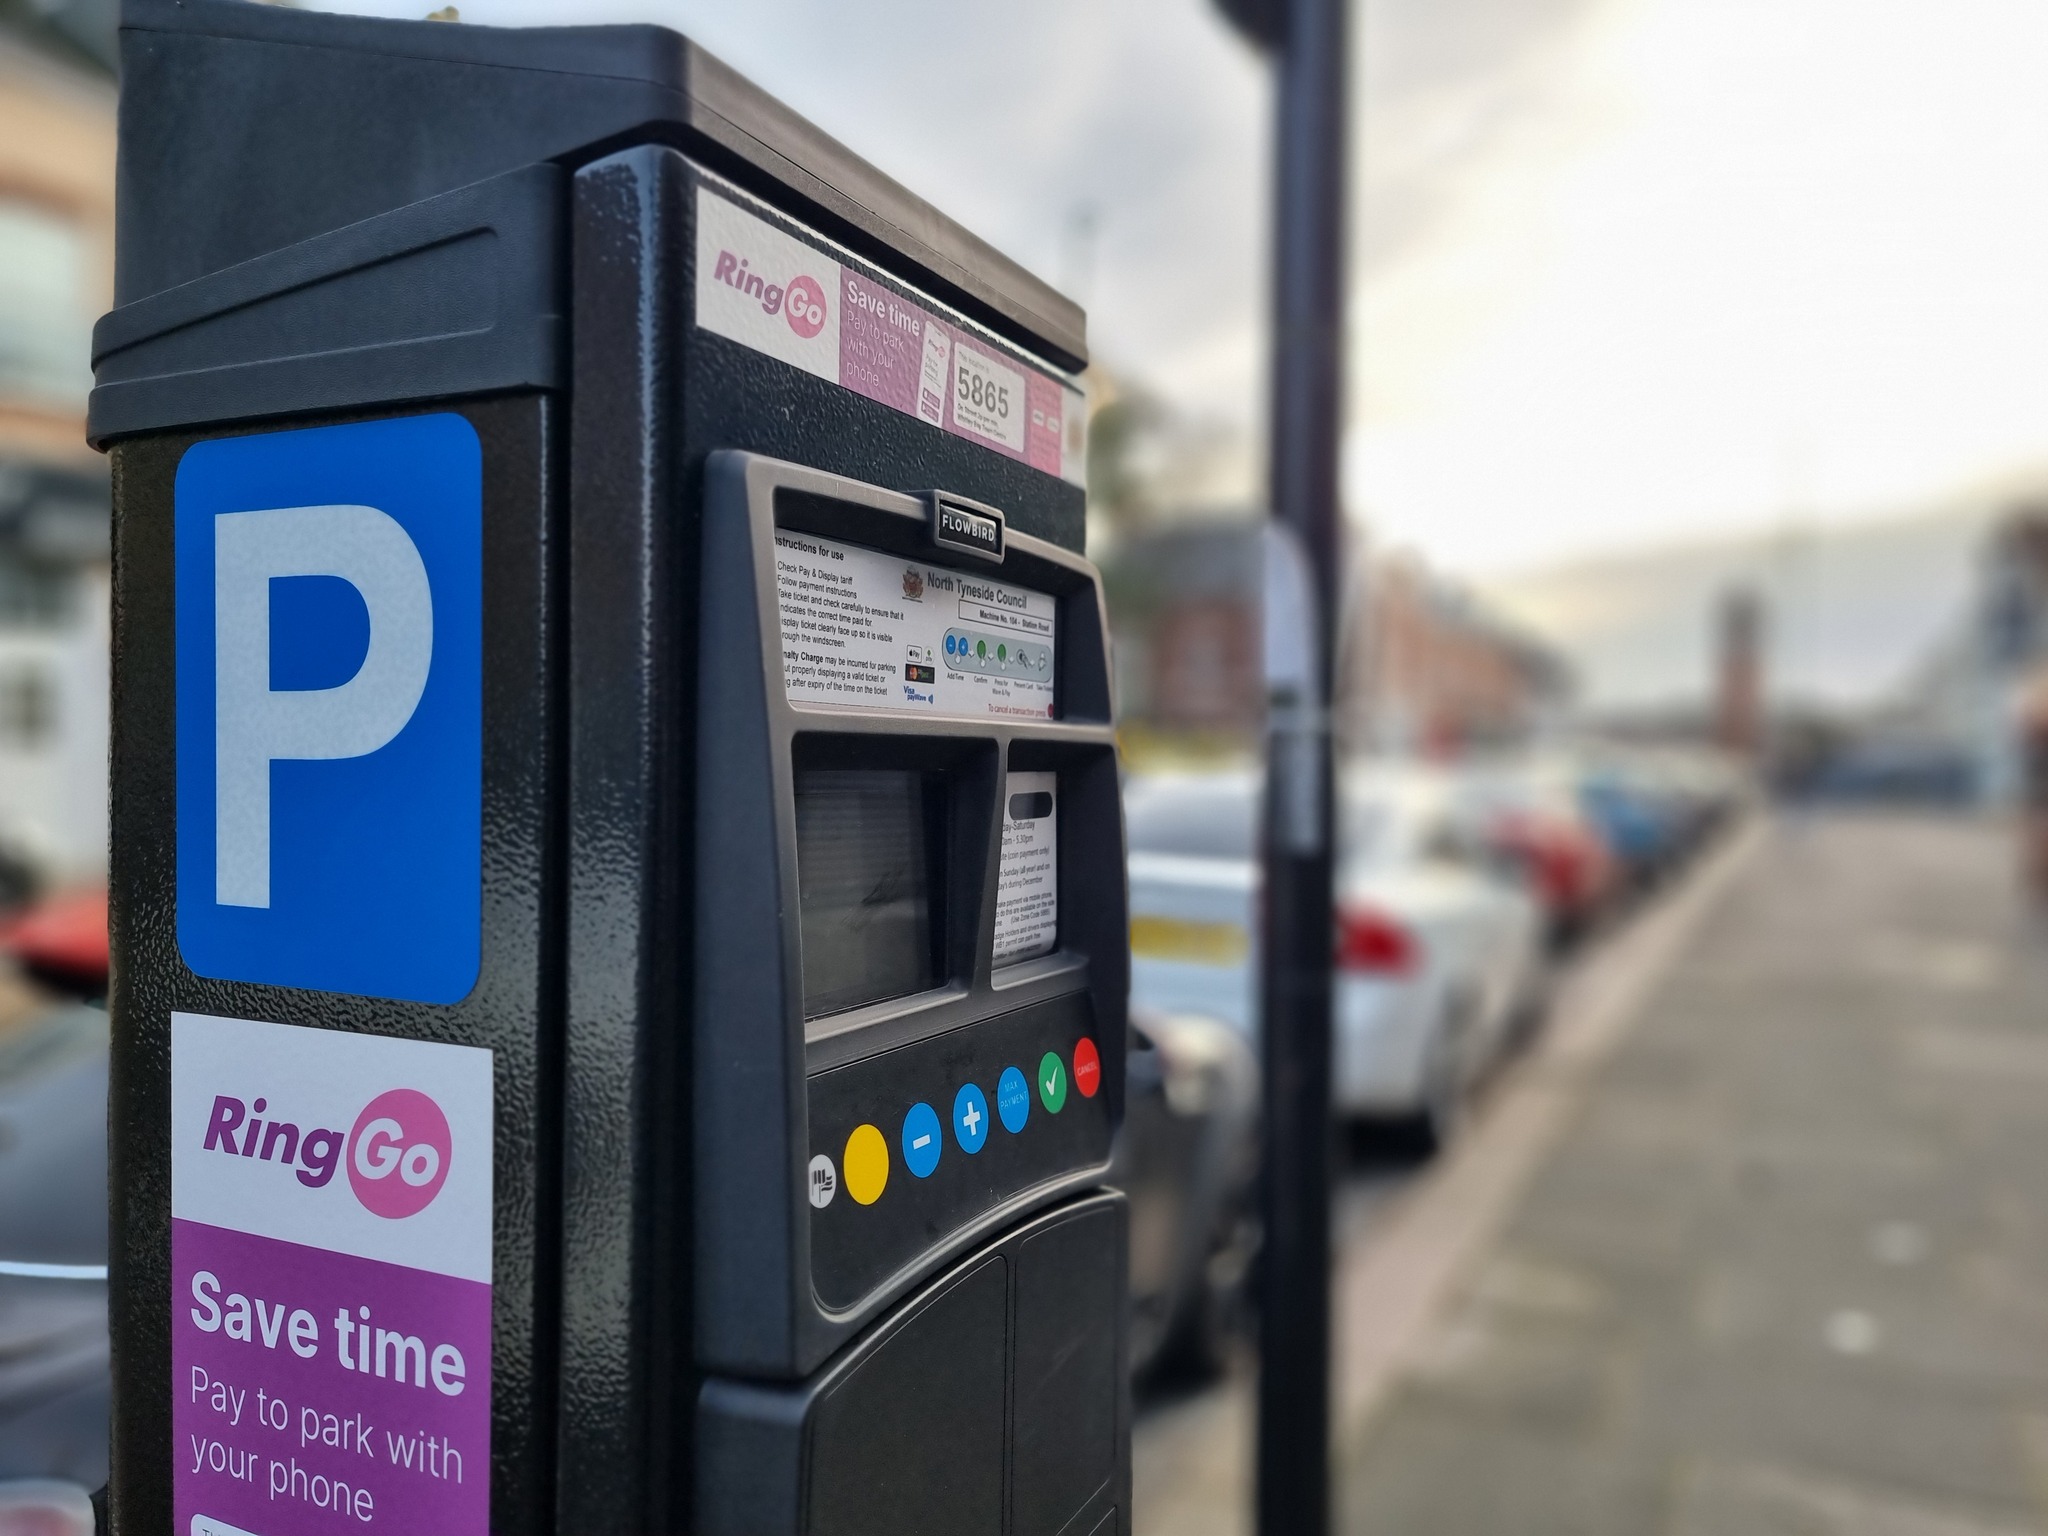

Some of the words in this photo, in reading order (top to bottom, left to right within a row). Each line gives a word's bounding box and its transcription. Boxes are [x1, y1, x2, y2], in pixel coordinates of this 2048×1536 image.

[714, 250, 822, 326] RingGo
[847, 280, 885, 319] Save
[889, 304, 920, 336] time
[847, 310, 866, 336] Pay
[869, 326, 880, 340] to
[883, 331, 904, 353] park
[847, 337, 868, 359] with
[872, 353, 895, 370] your
[847, 362, 880, 387] phone
[958, 366, 1008, 419] 5865
[942, 514, 995, 542] FLOWBIRD
[775, 536, 817, 555] nstructions
[819, 545, 829, 557] for
[831, 551, 844, 561] use
[778, 561, 797, 573] Check
[799, 565, 810, 578] Pay
[812, 568, 817, 577] &
[818, 569, 839, 584] Display
[840, 575, 853, 585] tariff
[778, 574, 797, 586] Follow
[799, 580, 824, 592] payment
[826, 584, 857, 599] instructions
[927, 571, 953, 592] North
[956, 578, 994, 601] Tyneside
[996, 589, 1027, 609] Council
[780, 604, 806, 615] ndicates
[807, 608, 817, 617] the
[818, 611, 838, 622] correct
[839, 613, 851, 623] time
[852, 616, 864, 625] paid
[793, 591, 809, 603] ticket
[811, 596, 822, 605] and
[823, 598, 840, 608] check
[841, 602, 864, 615] carefully
[865, 606, 870, 614] to
[871, 608, 888, 618] ensure
[890, 610, 899, 620] that
[782, 616, 799, 629] isplay
[801, 619, 817, 630] ticket
[818, 623, 836, 635] clearly
[838, 626, 850, 635] face
[851, 630, 858, 638] up
[871, 631, 876, 640] is
[877, 633, 893, 643] visible
[980, 609, 999, 622] Machine
[1022, 619, 1037, 630] Station
[1038, 623, 1050, 632] Road
[782, 632, 800, 643] rough
[801, 634, 811, 643] the
[783, 650, 799, 662] nalty
[801, 652, 824, 665] Charge
[825, 656, 837, 667] may
[839, 657, 845, 666] be
[847, 658, 868, 669] incurred
[878, 663, 896, 674] parking
[792, 665, 816, 677] properly
[818, 668, 845, 681] displaying
[852, 671, 864, 681] valid
[865, 673, 879, 682] ticket
[792, 678, 806, 687] after
[808, 681, 825, 691] expiry
[826, 681, 832, 690] of
[833, 682, 842, 691] the
[843, 683, 855, 692] time
[864, 685, 873, 694] the
[874, 686, 888, 696] ticket
[903, 686, 915, 695] Visa
[215, 505, 433, 909] P
[1076, 1061, 1097, 1077] CANCEL
[1004, 1080, 1018, 1093] MAX
[1000, 1090, 1028, 1110] PAYMENT
[203, 1095, 440, 1189] RingGo
[190, 1270, 319, 1358] Save
[334, 1305, 466, 1396] time
[191, 1365, 246, 1425] Pay
[257, 1387, 288, 1432] to
[301, 1405, 375, 1458] park
[387, 1431, 464, 1484] with
[191, 1433, 258, 1482] your
[270, 1457, 374, 1523] phone
